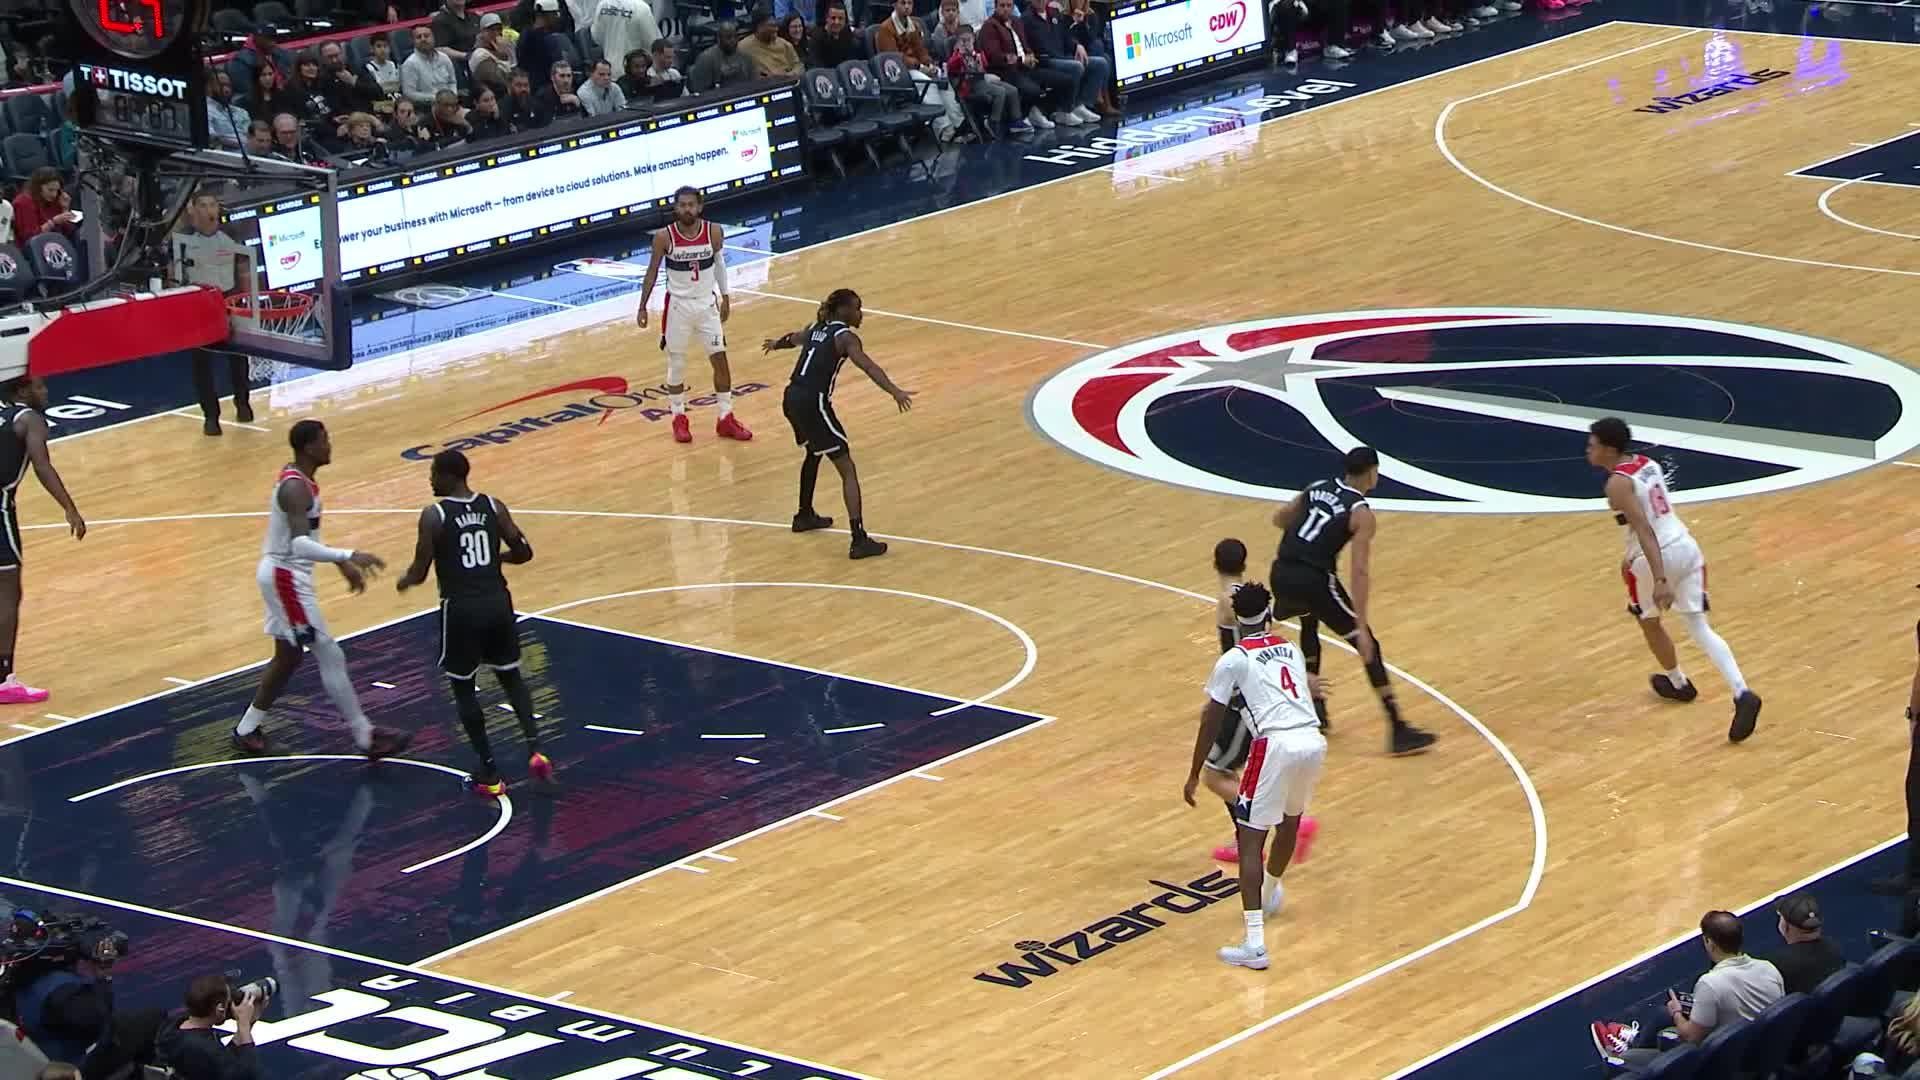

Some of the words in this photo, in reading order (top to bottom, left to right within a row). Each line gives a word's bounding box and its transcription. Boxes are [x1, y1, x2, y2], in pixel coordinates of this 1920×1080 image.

[1144, 22, 1192, 49] Microsoft
[1209, 10, 1237, 31] CDW
[109, 69, 187, 100] TISSOT
[1024, 114, 1233, 166] Hidden
[1202, 78, 1358, 116] Level
[361, 226, 383, 243] your
[384, 217, 427, 234] business
[428, 211, 448, 224] with
[450, 200, 492, 219] Microsoft
[503, 194, 524, 207] from
[526, 187, 554, 201] device
[556, 184, 565, 194] to
[566, 177, 590, 192] cloud
[592, 170, 632, 187] solutions.
[634, 163, 657, 177] Make
[659, 155, 694, 170] amazing
[695, 146, 729, 161] happen.
[689, 260, 700, 282] 3
[800, 347, 816, 376] 1
[640, 383, 769, 421] Aea
[1298, 506, 1331, 542] 17
[460, 529, 491, 569] 30
[1281, 666, 1299, 699] 4
[973, 869, 1242, 988] wizards
